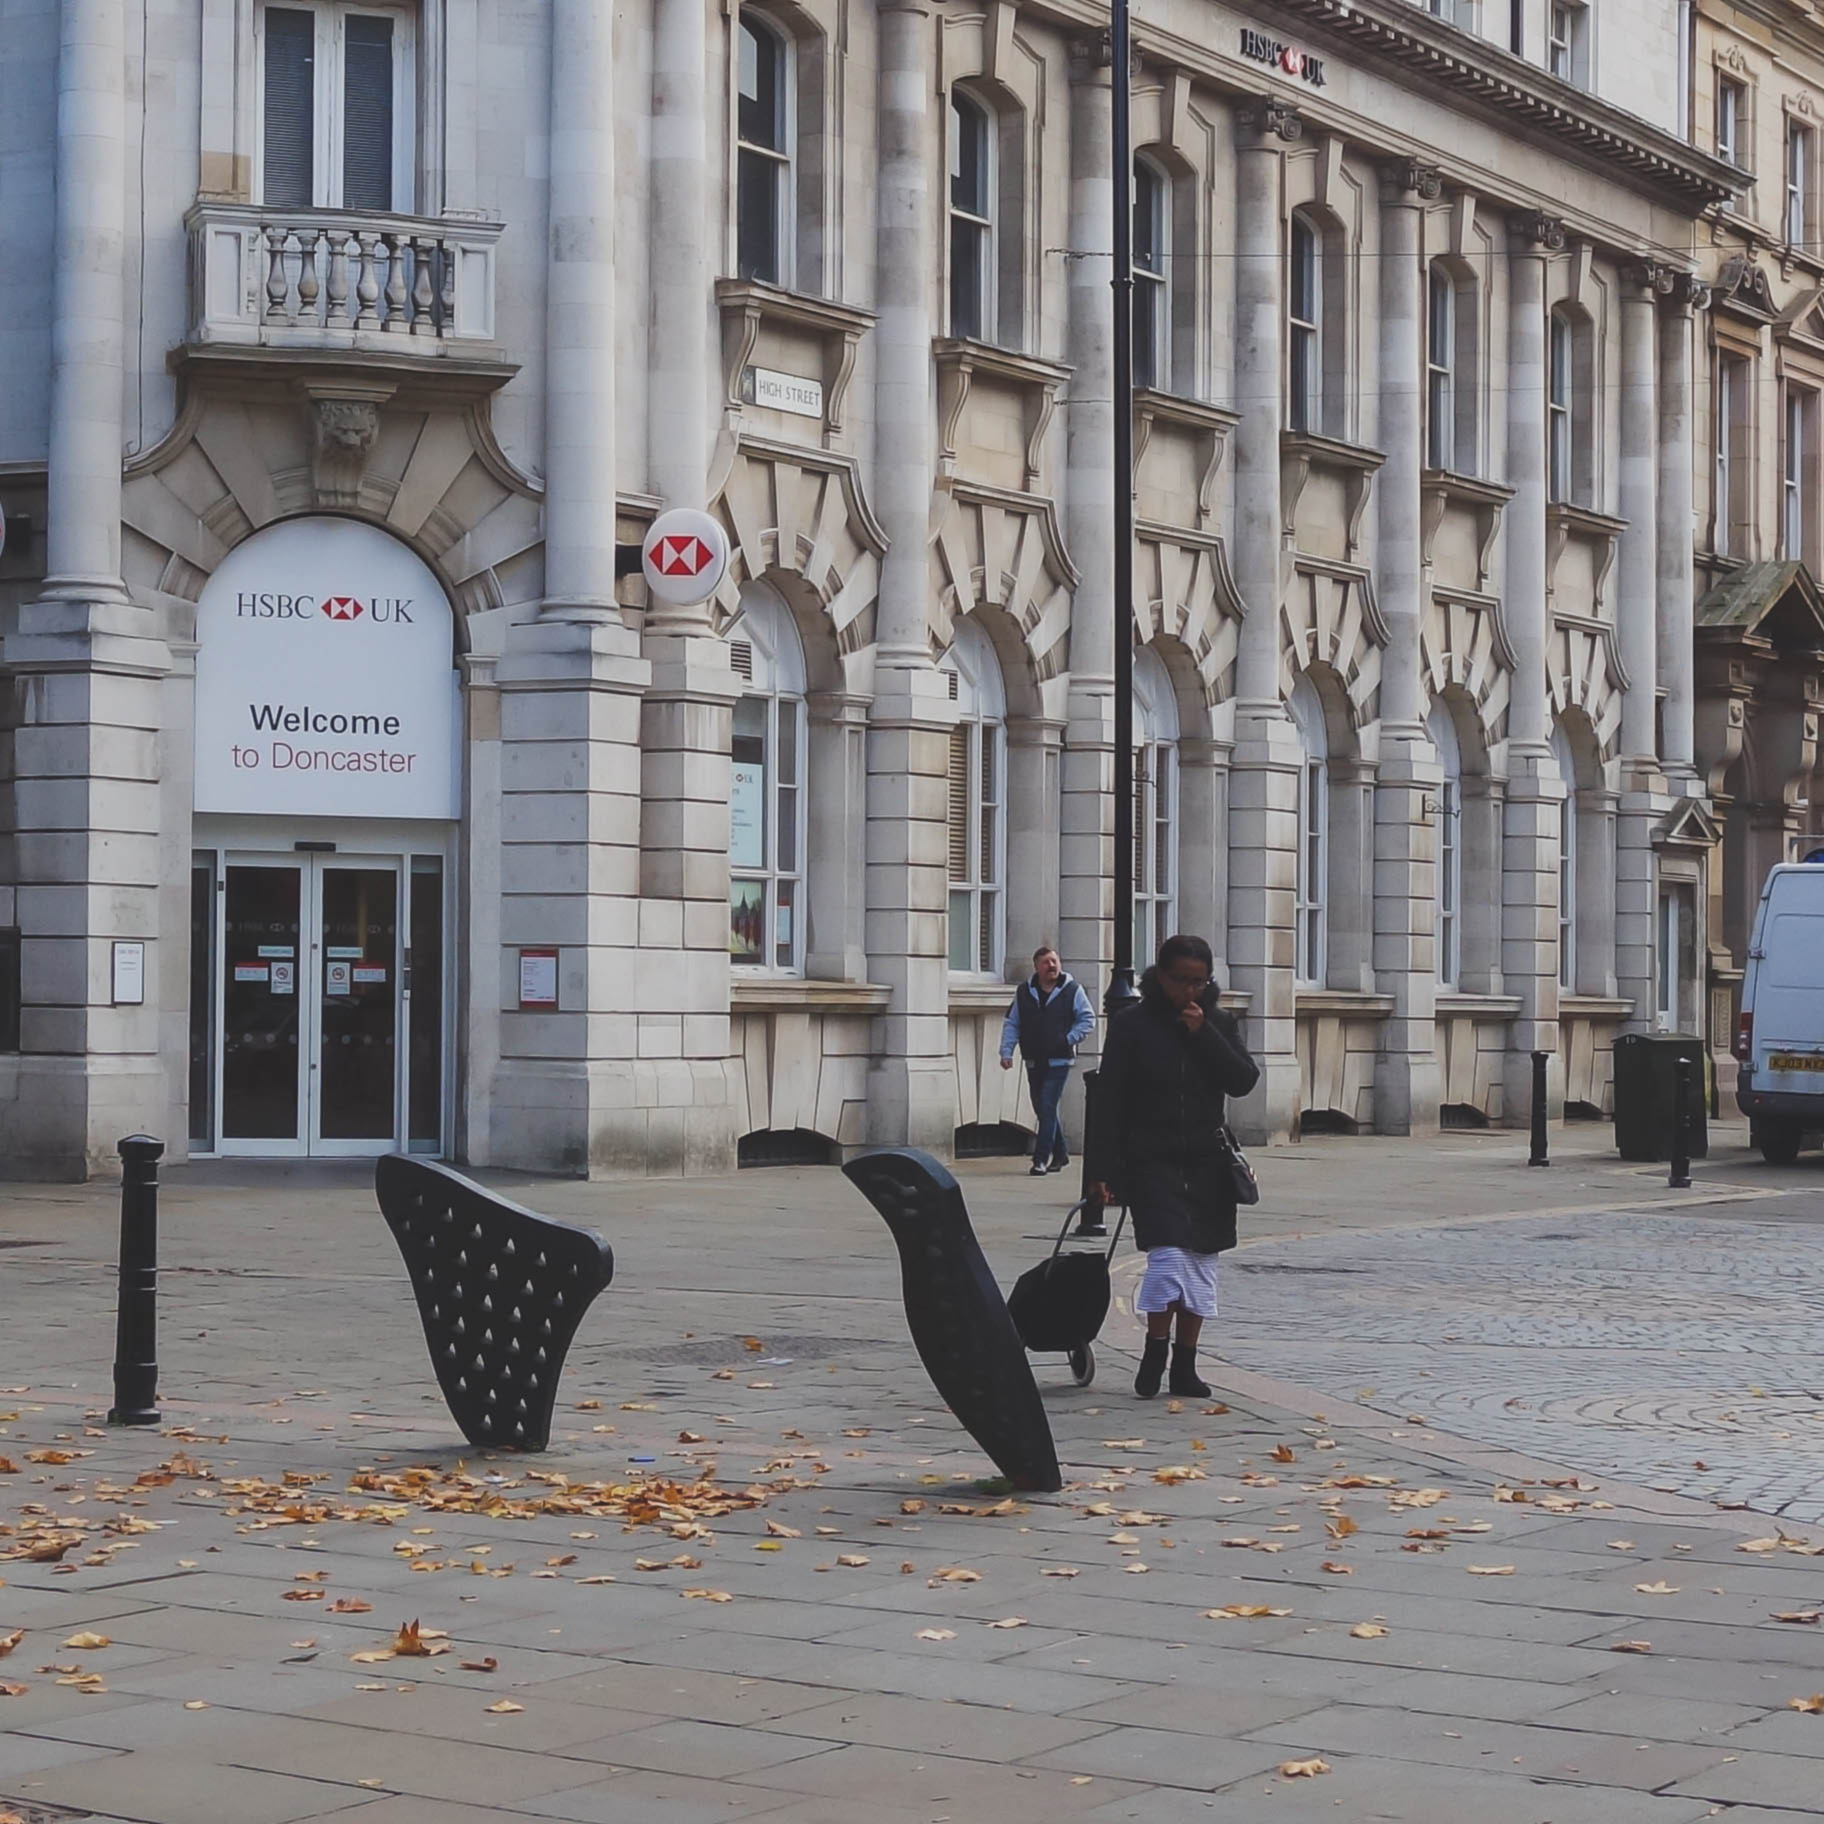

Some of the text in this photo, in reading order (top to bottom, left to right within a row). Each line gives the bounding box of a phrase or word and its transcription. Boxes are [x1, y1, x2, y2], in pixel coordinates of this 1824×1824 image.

[1241, 28, 1327, 87] HSBC UK
[758, 380, 820, 406] HIGH STREET
[237, 592, 415, 623] HSBC UK
[250, 704, 400, 736] Welcome
[232, 742, 417, 773] to Doncaster
